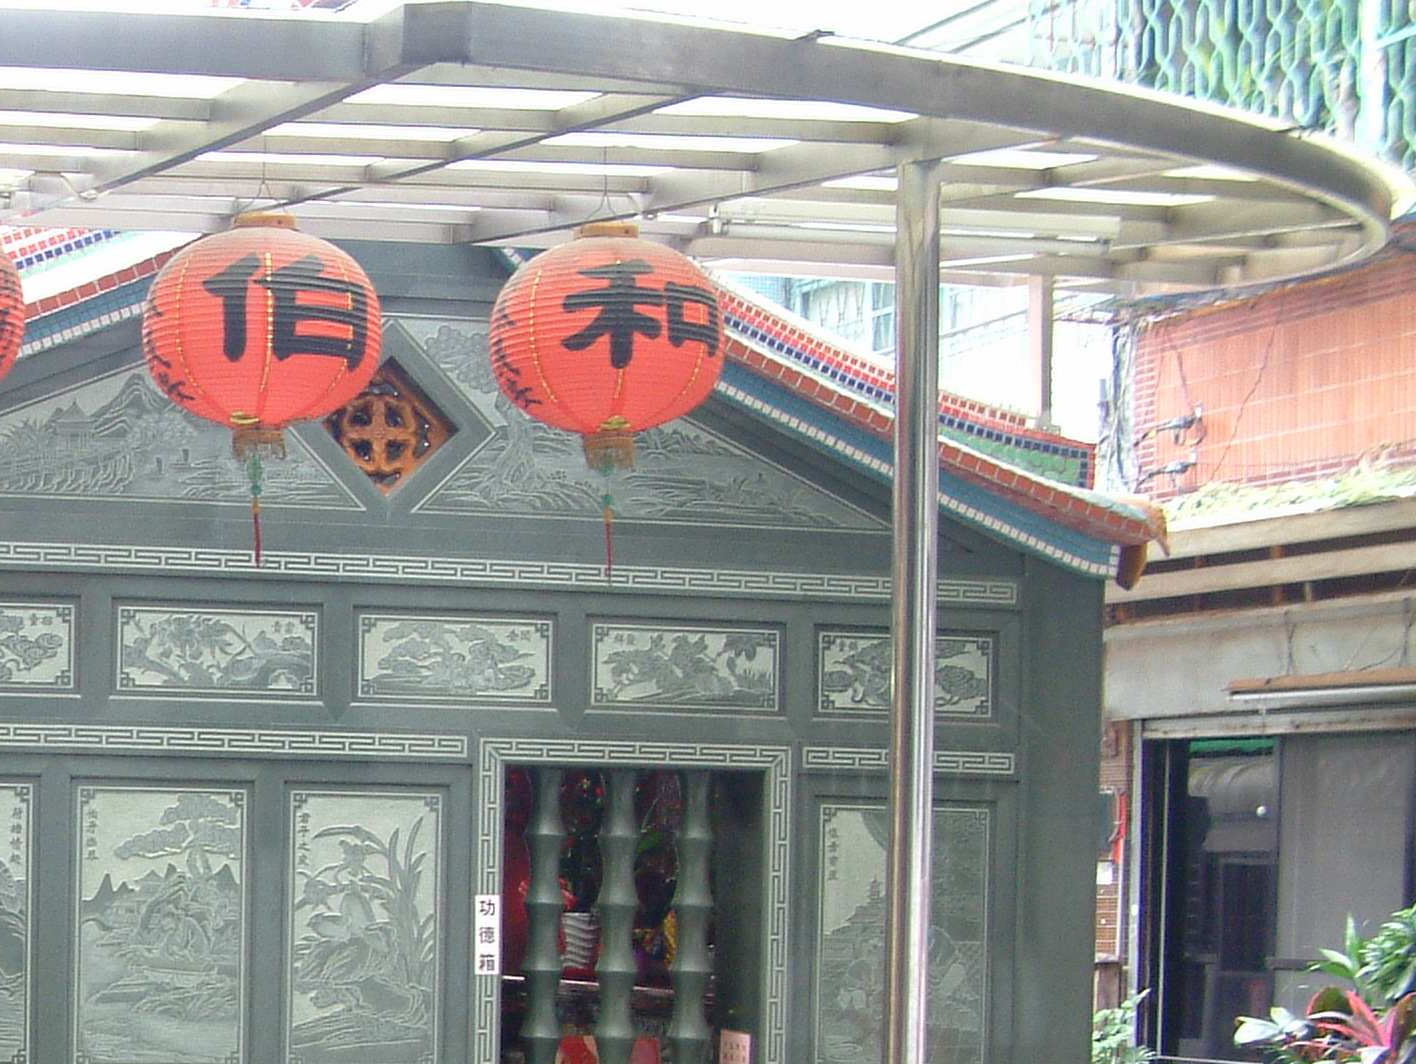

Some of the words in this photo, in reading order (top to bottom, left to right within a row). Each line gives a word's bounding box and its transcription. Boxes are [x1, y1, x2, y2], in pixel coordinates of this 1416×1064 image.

[201, 252, 369, 372] 伯
[561, 259, 720, 369] 和
[478, 898, 496, 971] 功德箱
